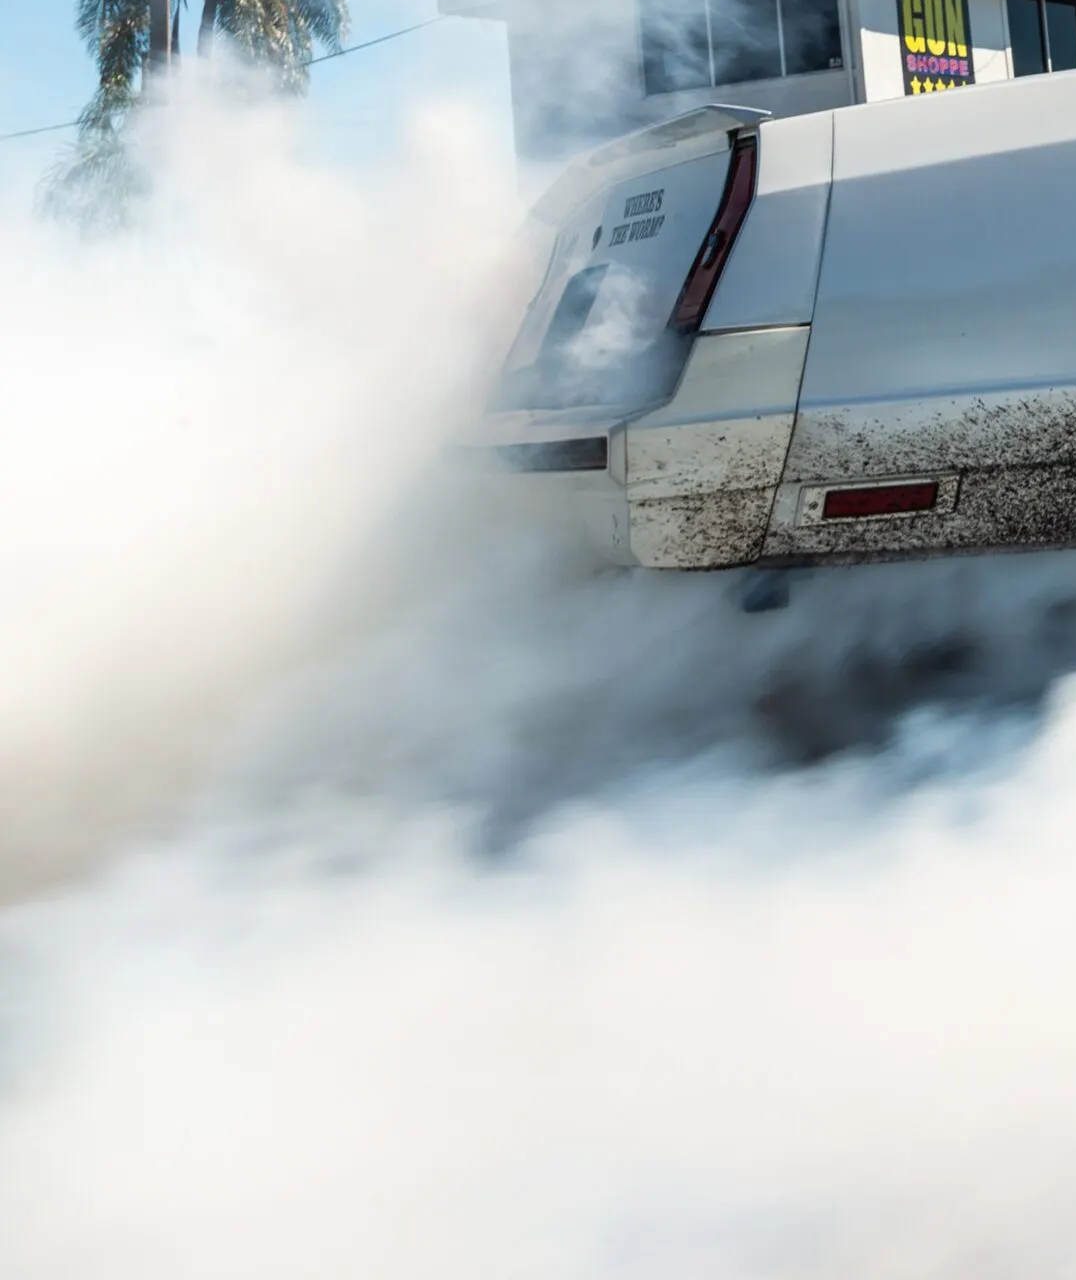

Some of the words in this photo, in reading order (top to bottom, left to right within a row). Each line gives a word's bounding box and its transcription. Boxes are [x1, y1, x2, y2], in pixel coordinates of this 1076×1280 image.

[906, 54, 969, 76] SHOPPE
[624, 188, 665, 218] WHERE'S
[609, 224, 628, 247] THE
